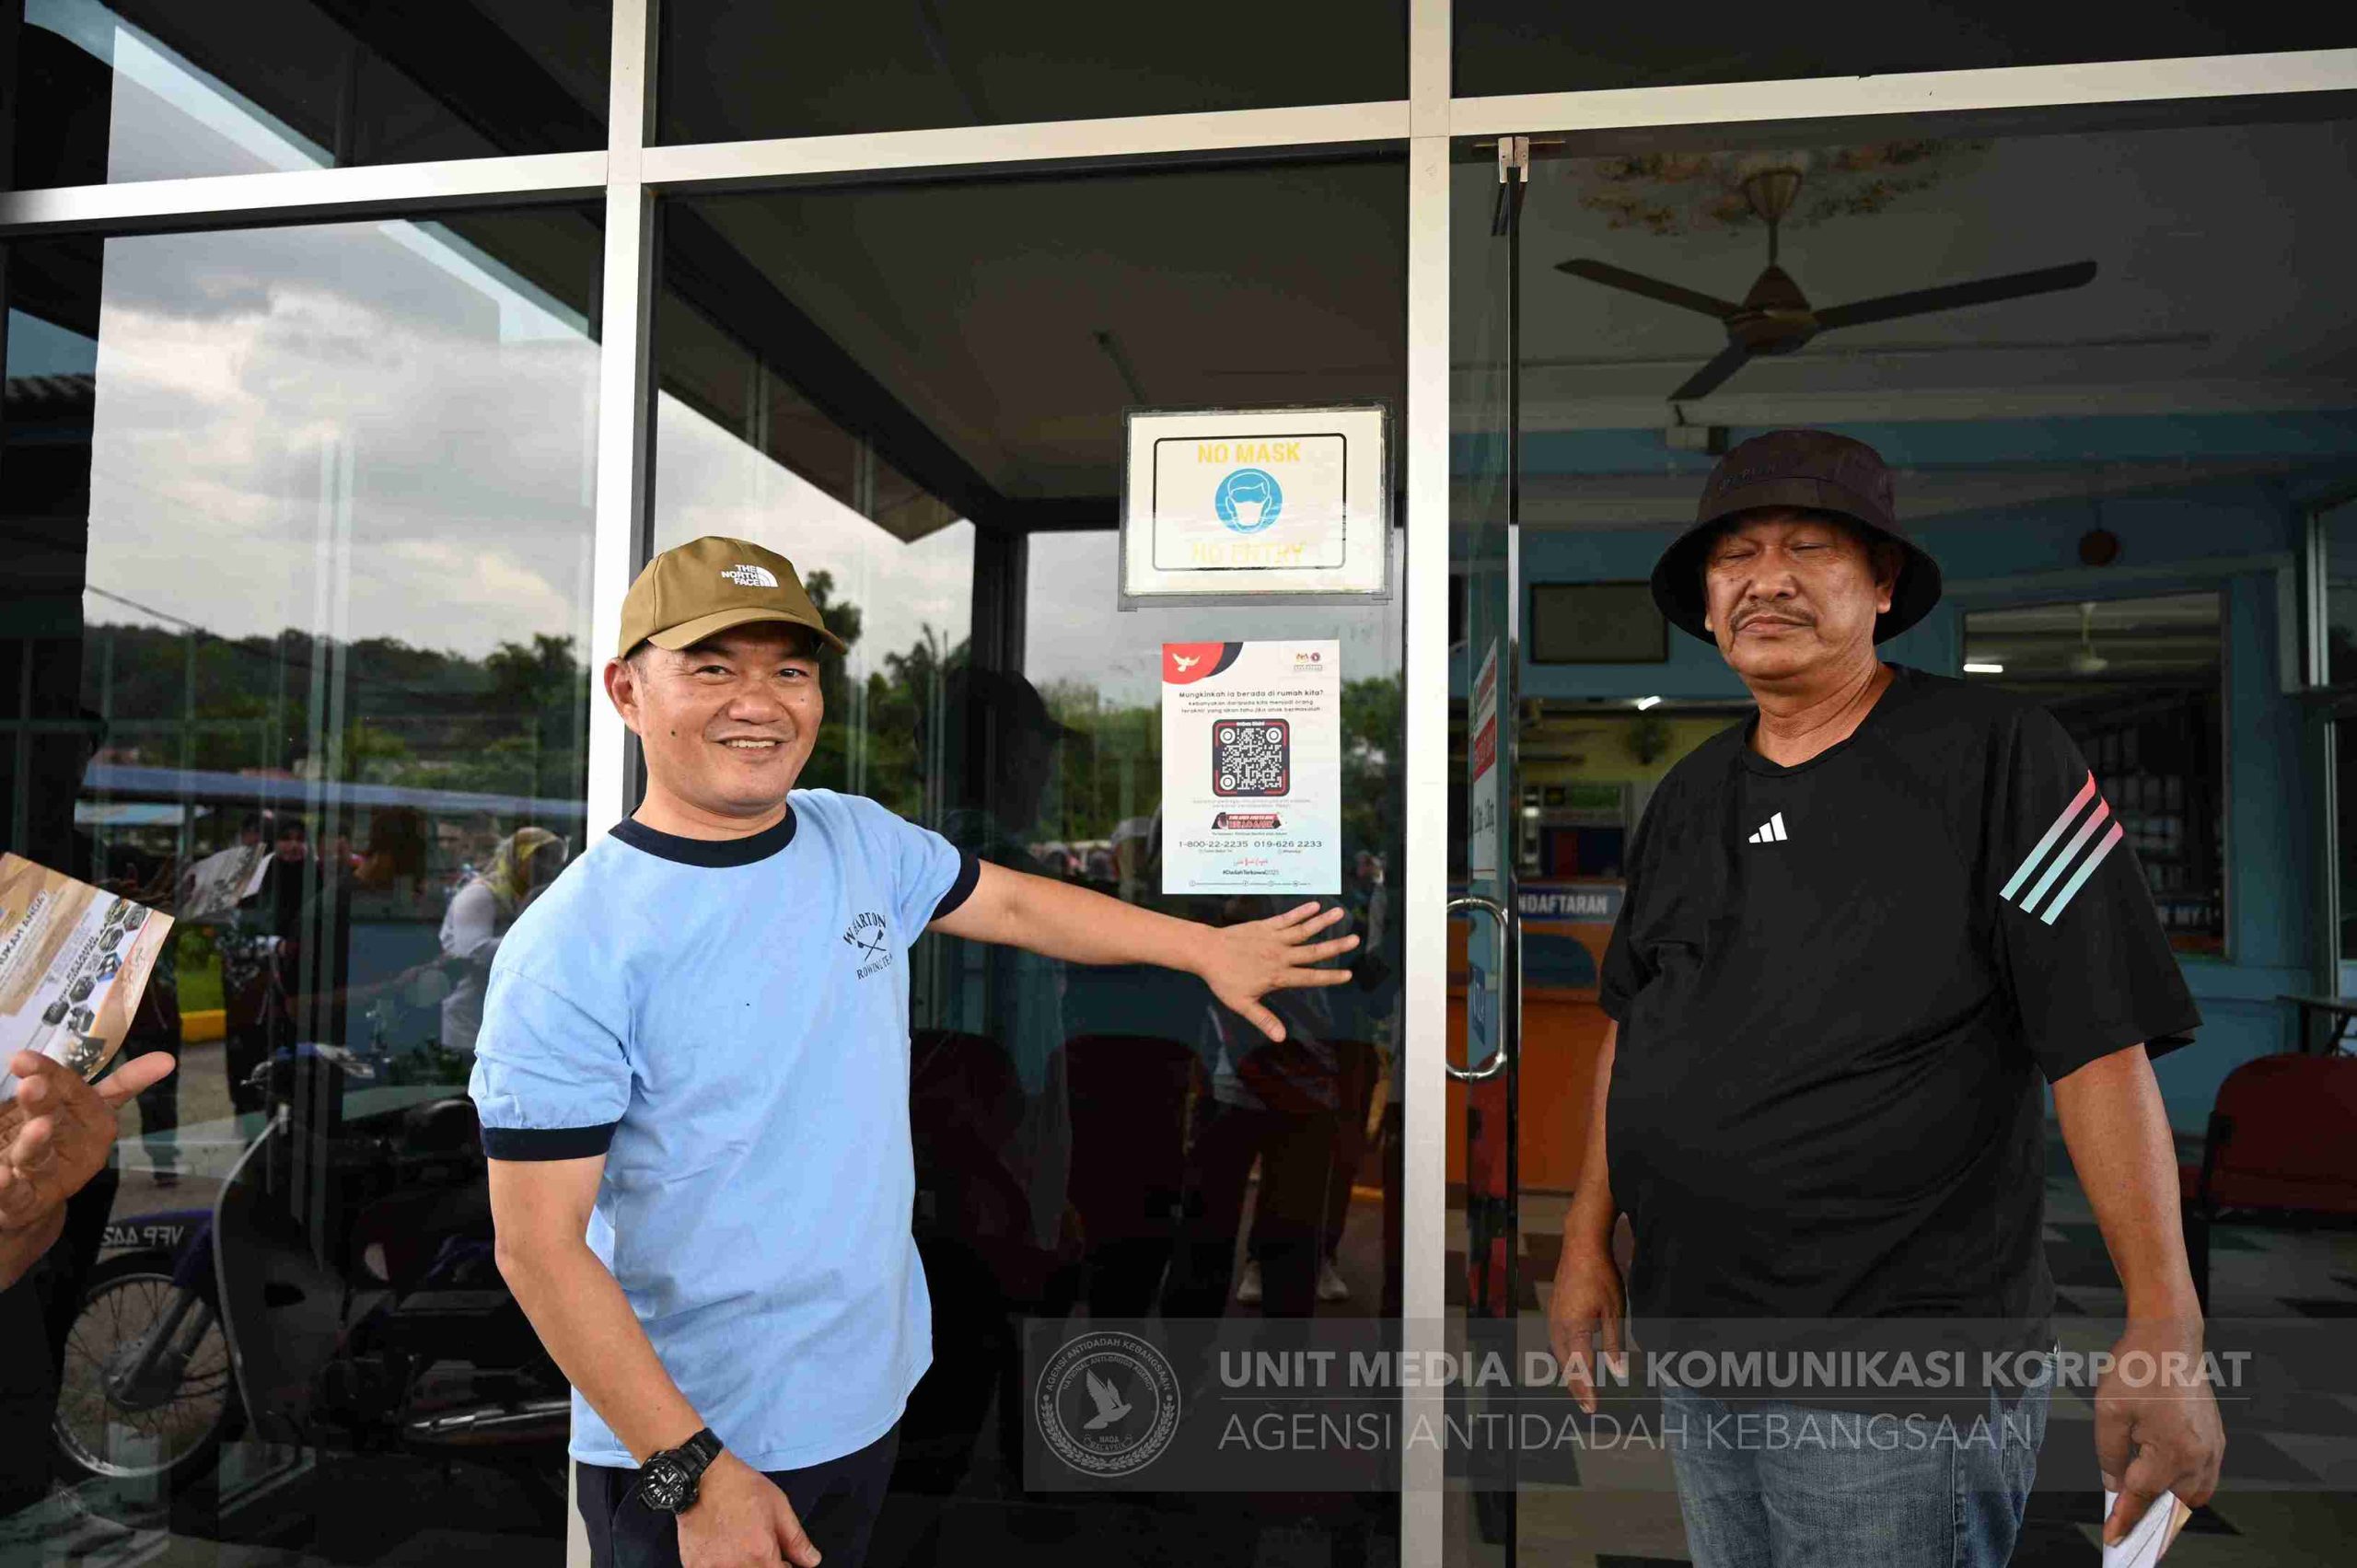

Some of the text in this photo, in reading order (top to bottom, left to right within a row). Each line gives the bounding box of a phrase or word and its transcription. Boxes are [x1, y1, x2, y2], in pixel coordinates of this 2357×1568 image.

[1198, 442, 1302, 463] NO MASK
[1192, 542, 1224, 563] NO
[721, 571, 758, 579] NORTH
[1179, 691, 1225, 699] Mungkinkah
[1178, 840, 1322, 848] 1-800-22-2235 019-626 2233
